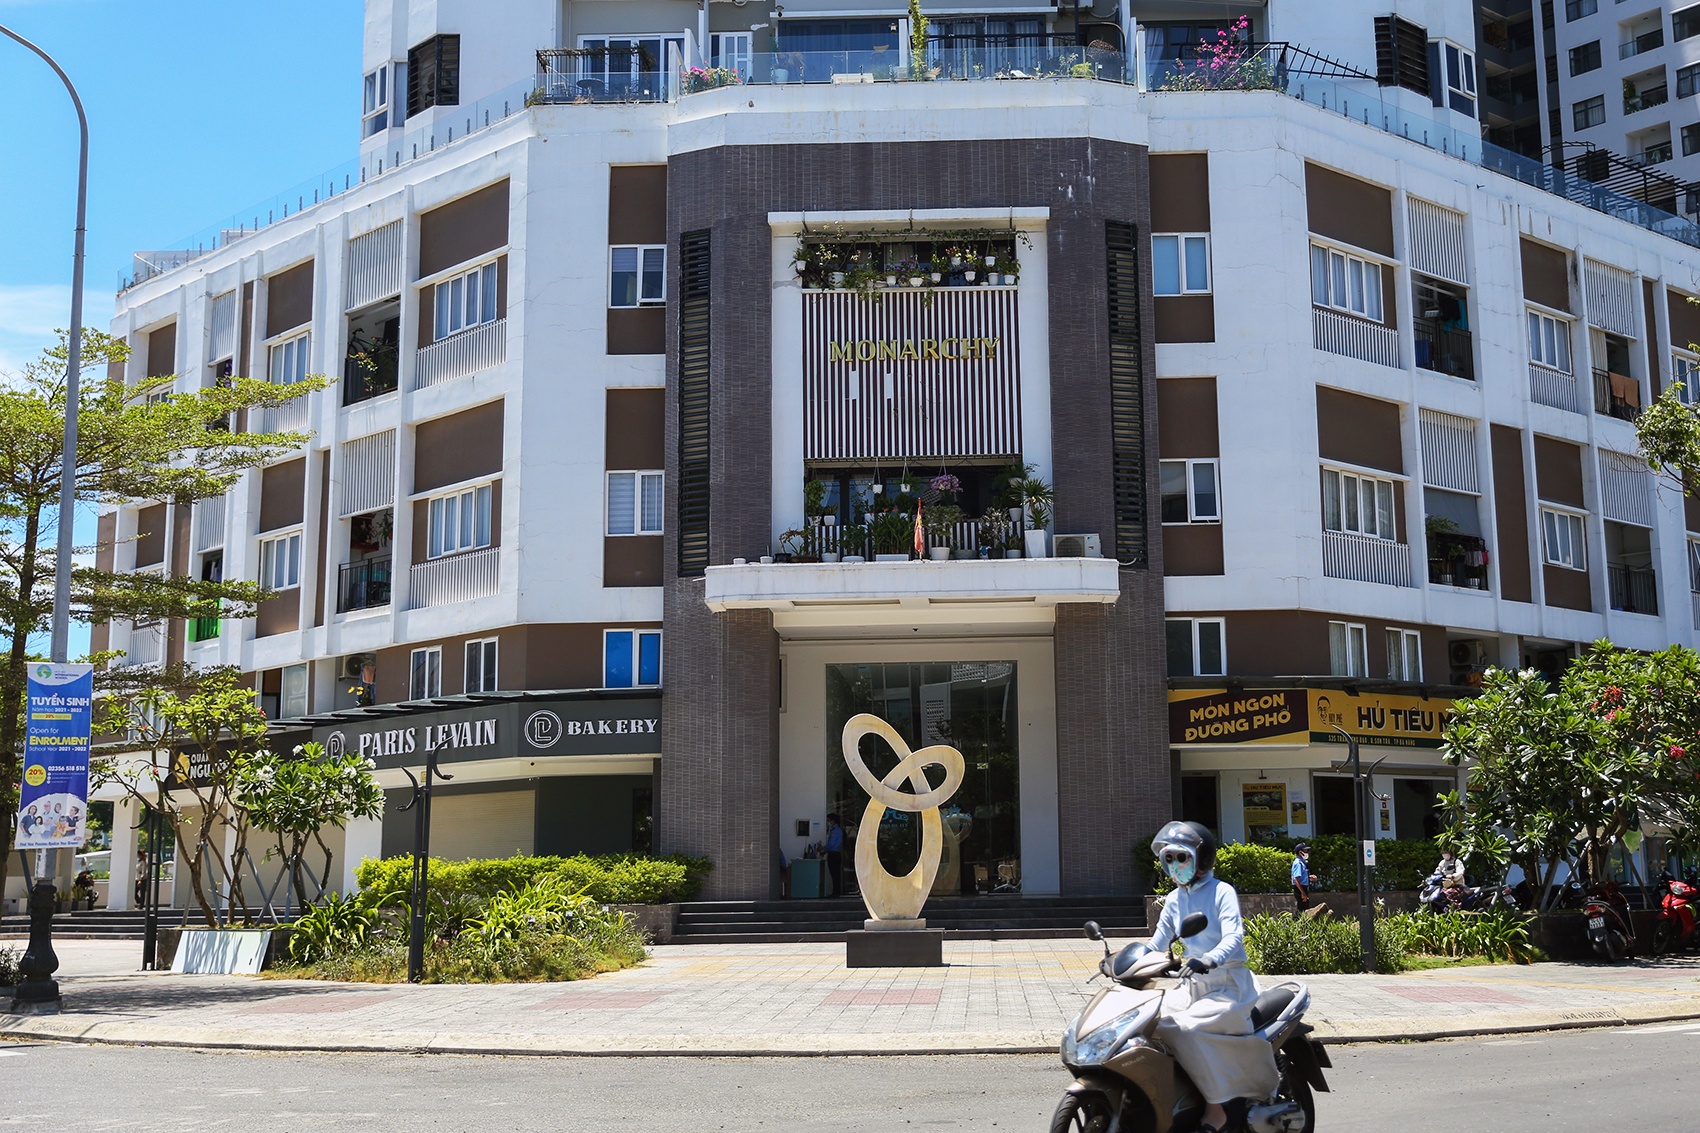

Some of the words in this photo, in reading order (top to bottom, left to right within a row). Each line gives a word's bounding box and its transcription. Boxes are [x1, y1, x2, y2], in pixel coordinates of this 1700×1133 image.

[829, 337, 1000, 362] MONARCHY
[31, 692, 65, 706] TUYỂN
[66, 697, 90, 706] SINH
[1233, 692, 1285, 715] NGON
[1357, 700, 1387, 730] HỦ
[359, 727, 416, 758] PARIS
[424, 718, 497, 752] LEVAIN
[567, 718, 659, 736] BAKERY
[29, 735, 88, 746] ENROLMENT
